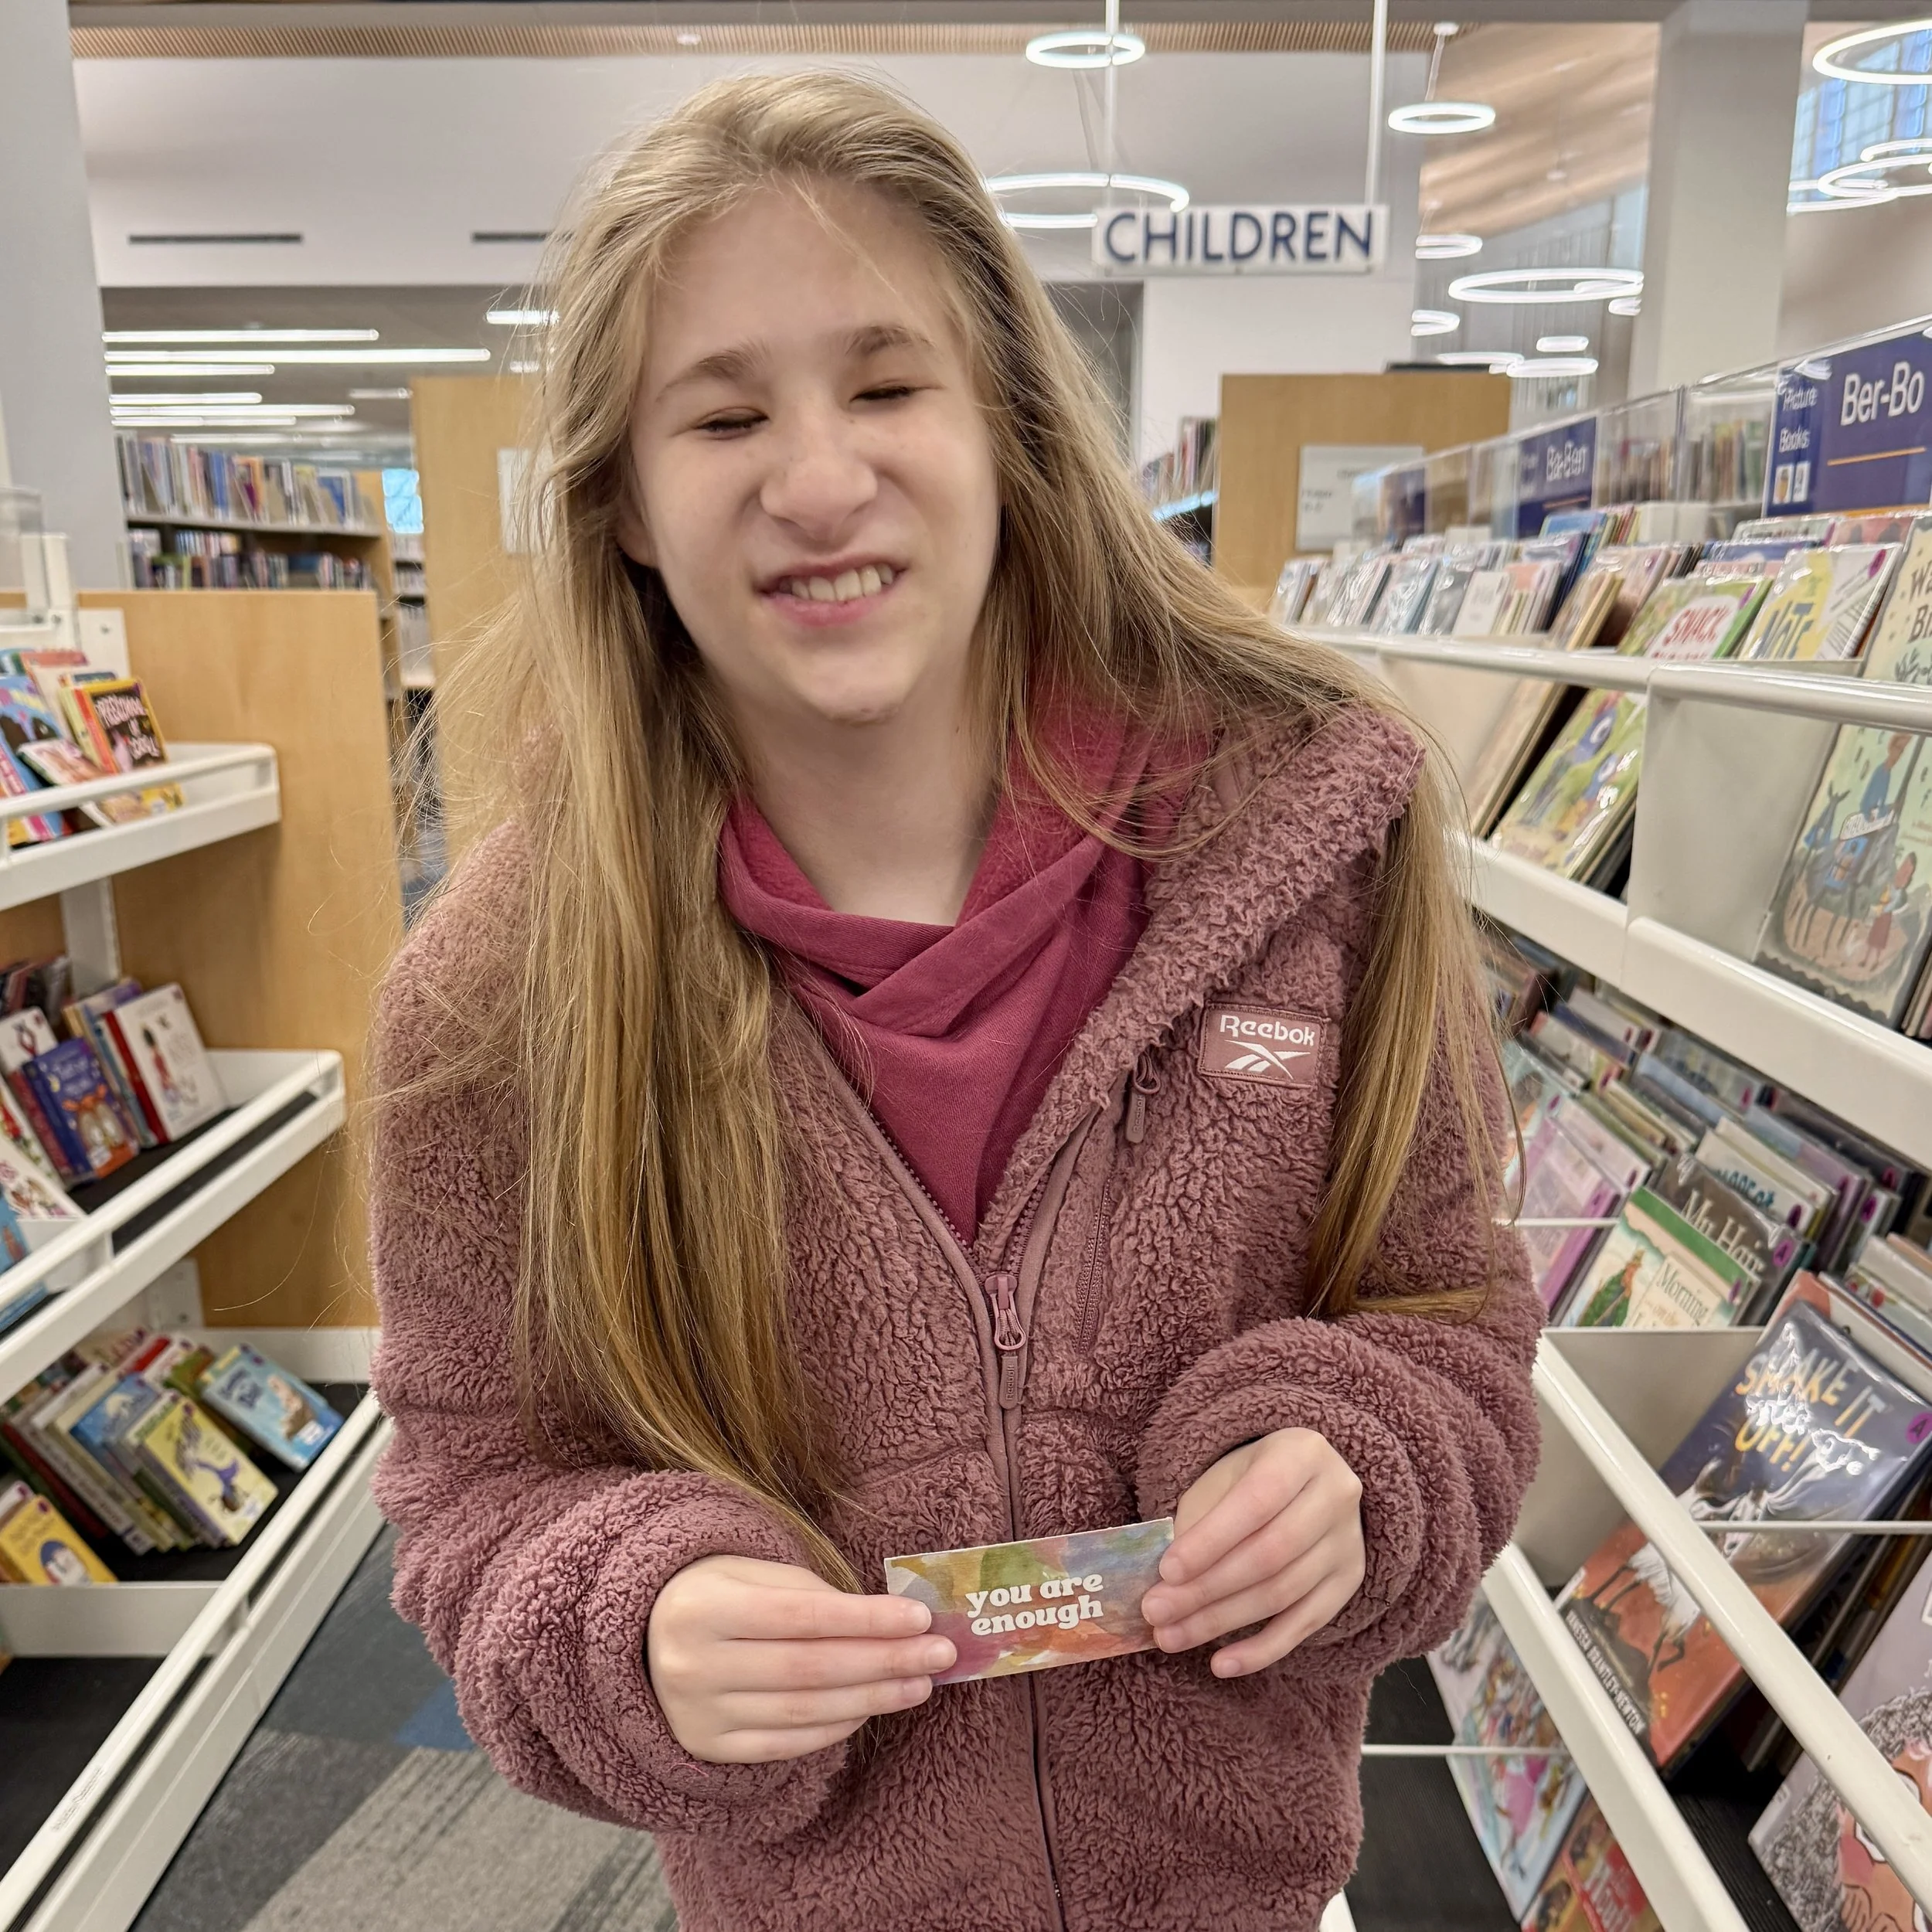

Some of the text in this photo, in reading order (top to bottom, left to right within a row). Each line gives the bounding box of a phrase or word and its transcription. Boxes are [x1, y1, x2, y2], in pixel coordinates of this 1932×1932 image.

[1105, 211, 1372, 264] CHILDREN
[1840, 361, 1925, 426] Ber-Bo
[1779, 427, 1810, 453] Books
[1219, 1014, 1315, 1046] Reebok
[1716, 1216, 1766, 1275] Hair
[1005, 1364, 1015, 1400] Reebok
[1833, 1386, 1888, 1439] IT
[964, 1573, 1104, 1618] you are
[971, 1594, 1104, 1636] enough
